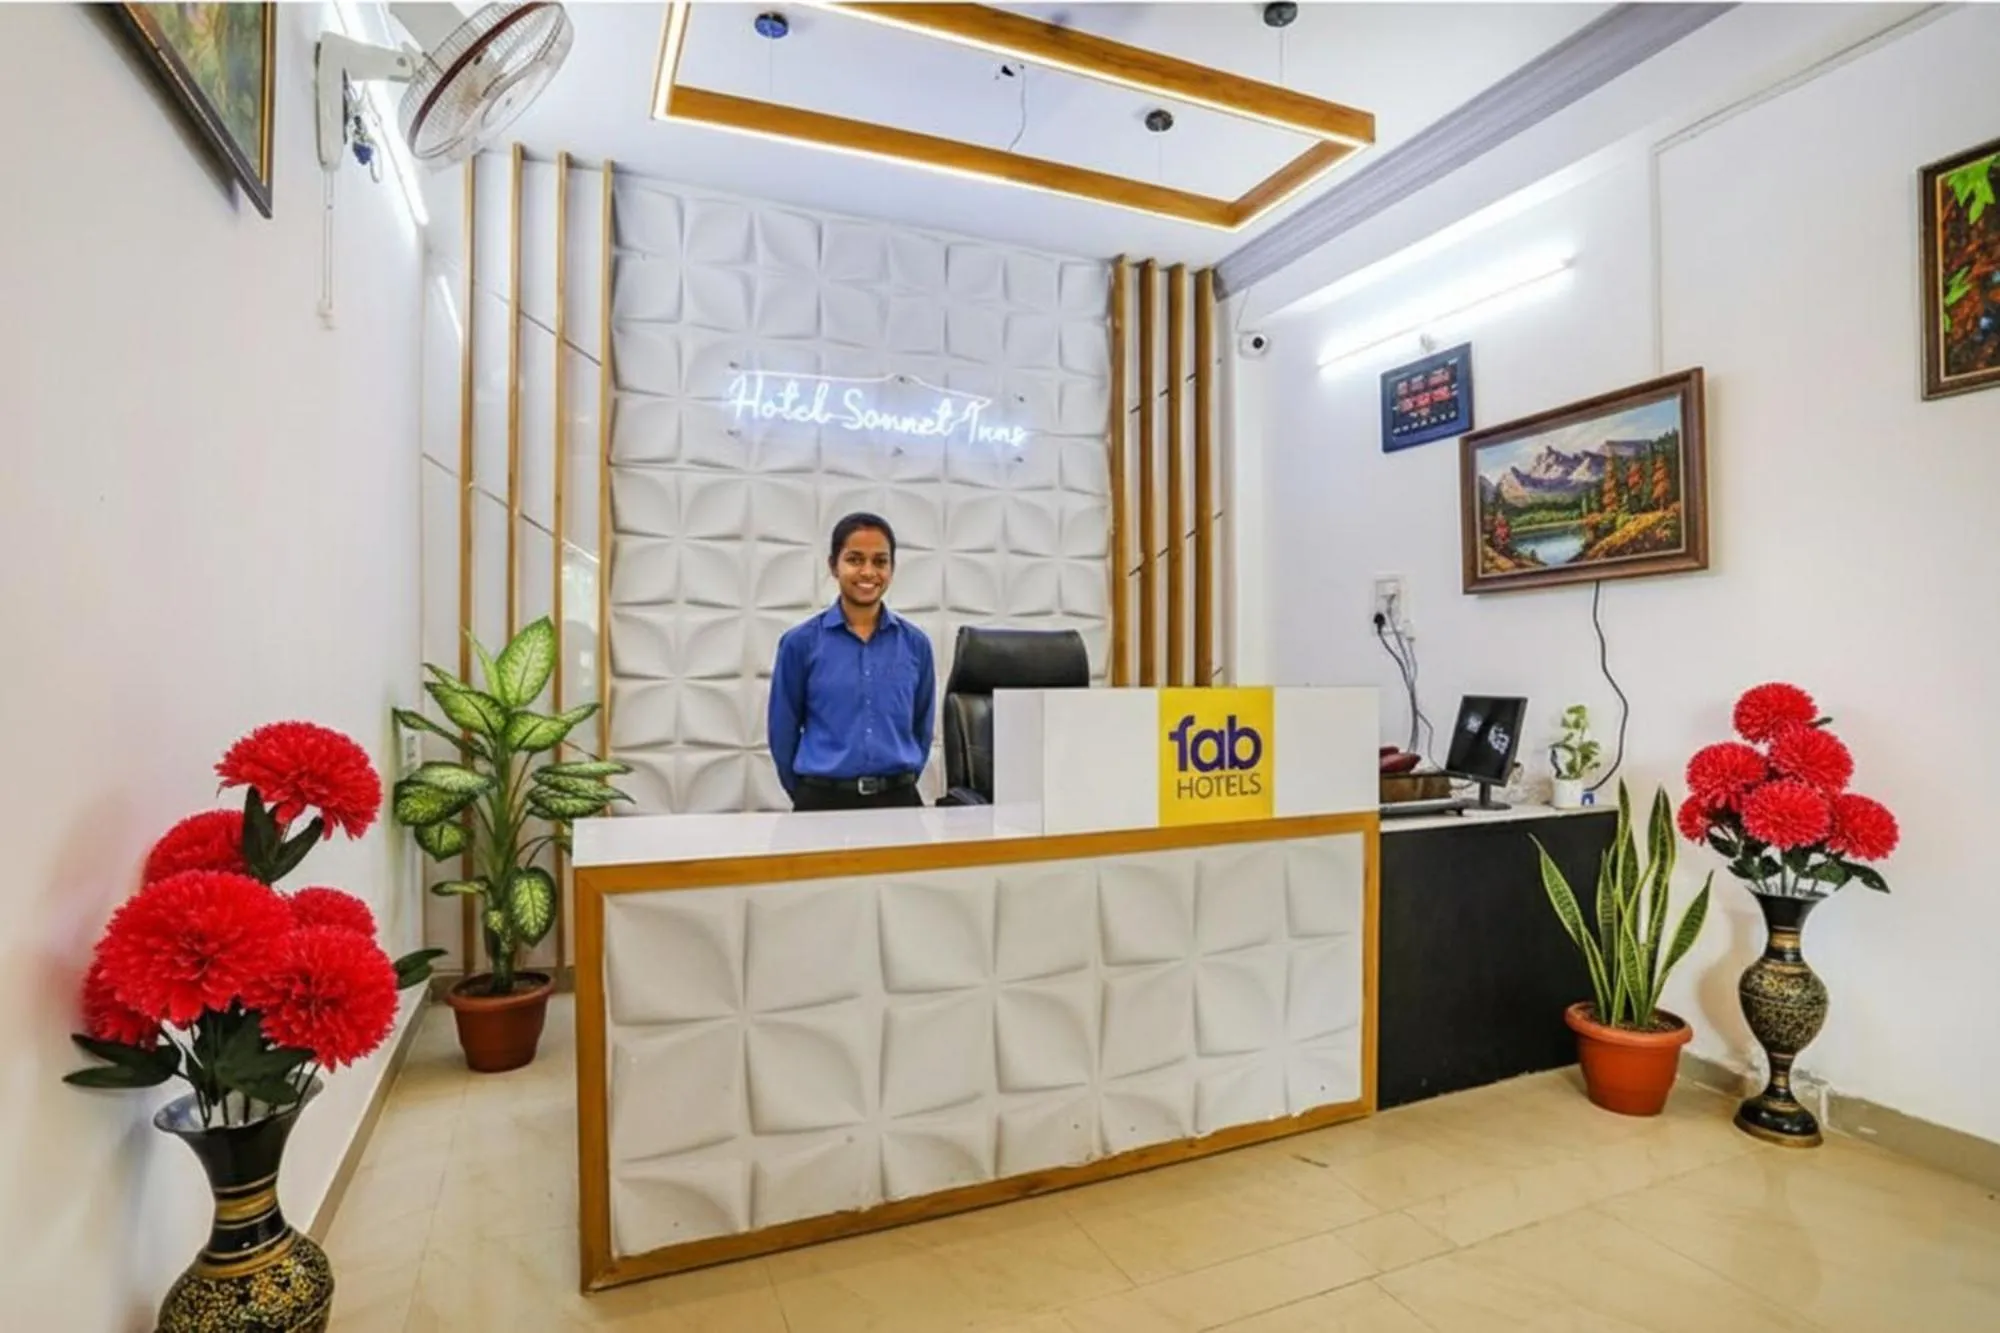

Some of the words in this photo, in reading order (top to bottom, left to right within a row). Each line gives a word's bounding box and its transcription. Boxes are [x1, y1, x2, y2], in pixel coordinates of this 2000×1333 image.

[728, 372, 834, 424] Hotel
[841, 387, 953, 436] Sonnet
[1168, 714, 1262, 773] fab
[1176, 772, 1262, 800] HOTELS
